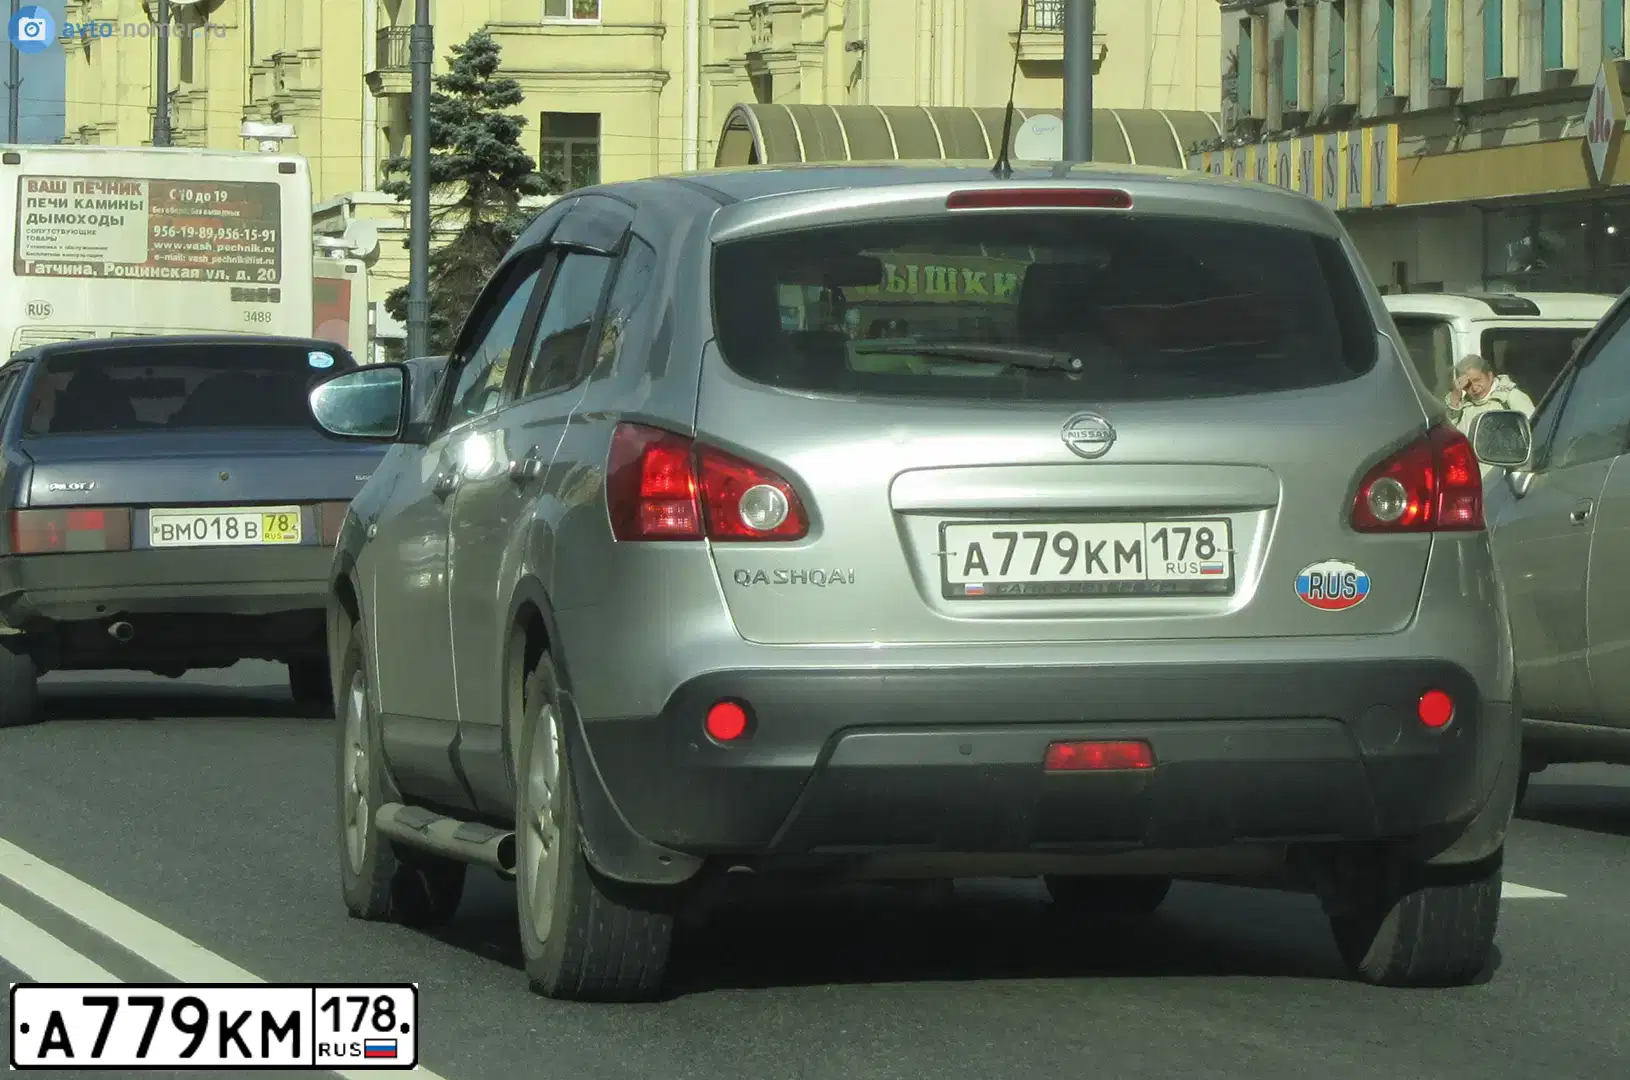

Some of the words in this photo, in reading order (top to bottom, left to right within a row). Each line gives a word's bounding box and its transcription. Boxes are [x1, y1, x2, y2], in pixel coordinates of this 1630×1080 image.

[27, 179, 67, 194] ВАШ
[72, 181, 143, 196] ПЕЧНИК
[26, 197, 68, 209] ПЕЧИ
[74, 198, 144, 211] КАМИНЫ
[195, 191, 211, 204] до
[213, 190, 228, 203] 19
[26, 213, 125, 227] ДЫМОХОДЫ
[26, 228, 97, 236] СОПУТСТВУЮЩИЕ
[154, 253, 186, 262] e-mail:
[103, 262, 200, 280] Рощинская
[206, 268, 230, 281] ул.
[235, 270, 251, 282] д.
[257, 268, 277, 282] 20
[27, 303, 51, 316] RUS
[243, 310, 272, 323] 3488
[1067, 430, 1112, 438] NISSAN
[265, 514, 289, 532] 78
[264, 532, 282, 540] RUS
[962, 530, 1142, 577] А779КМ
[1150, 526, 1216, 561] 178
[1165, 562, 1199, 575] RUS
[733, 568, 856, 588] QASHQAI
[1308, 571, 1357, 600] RUS
